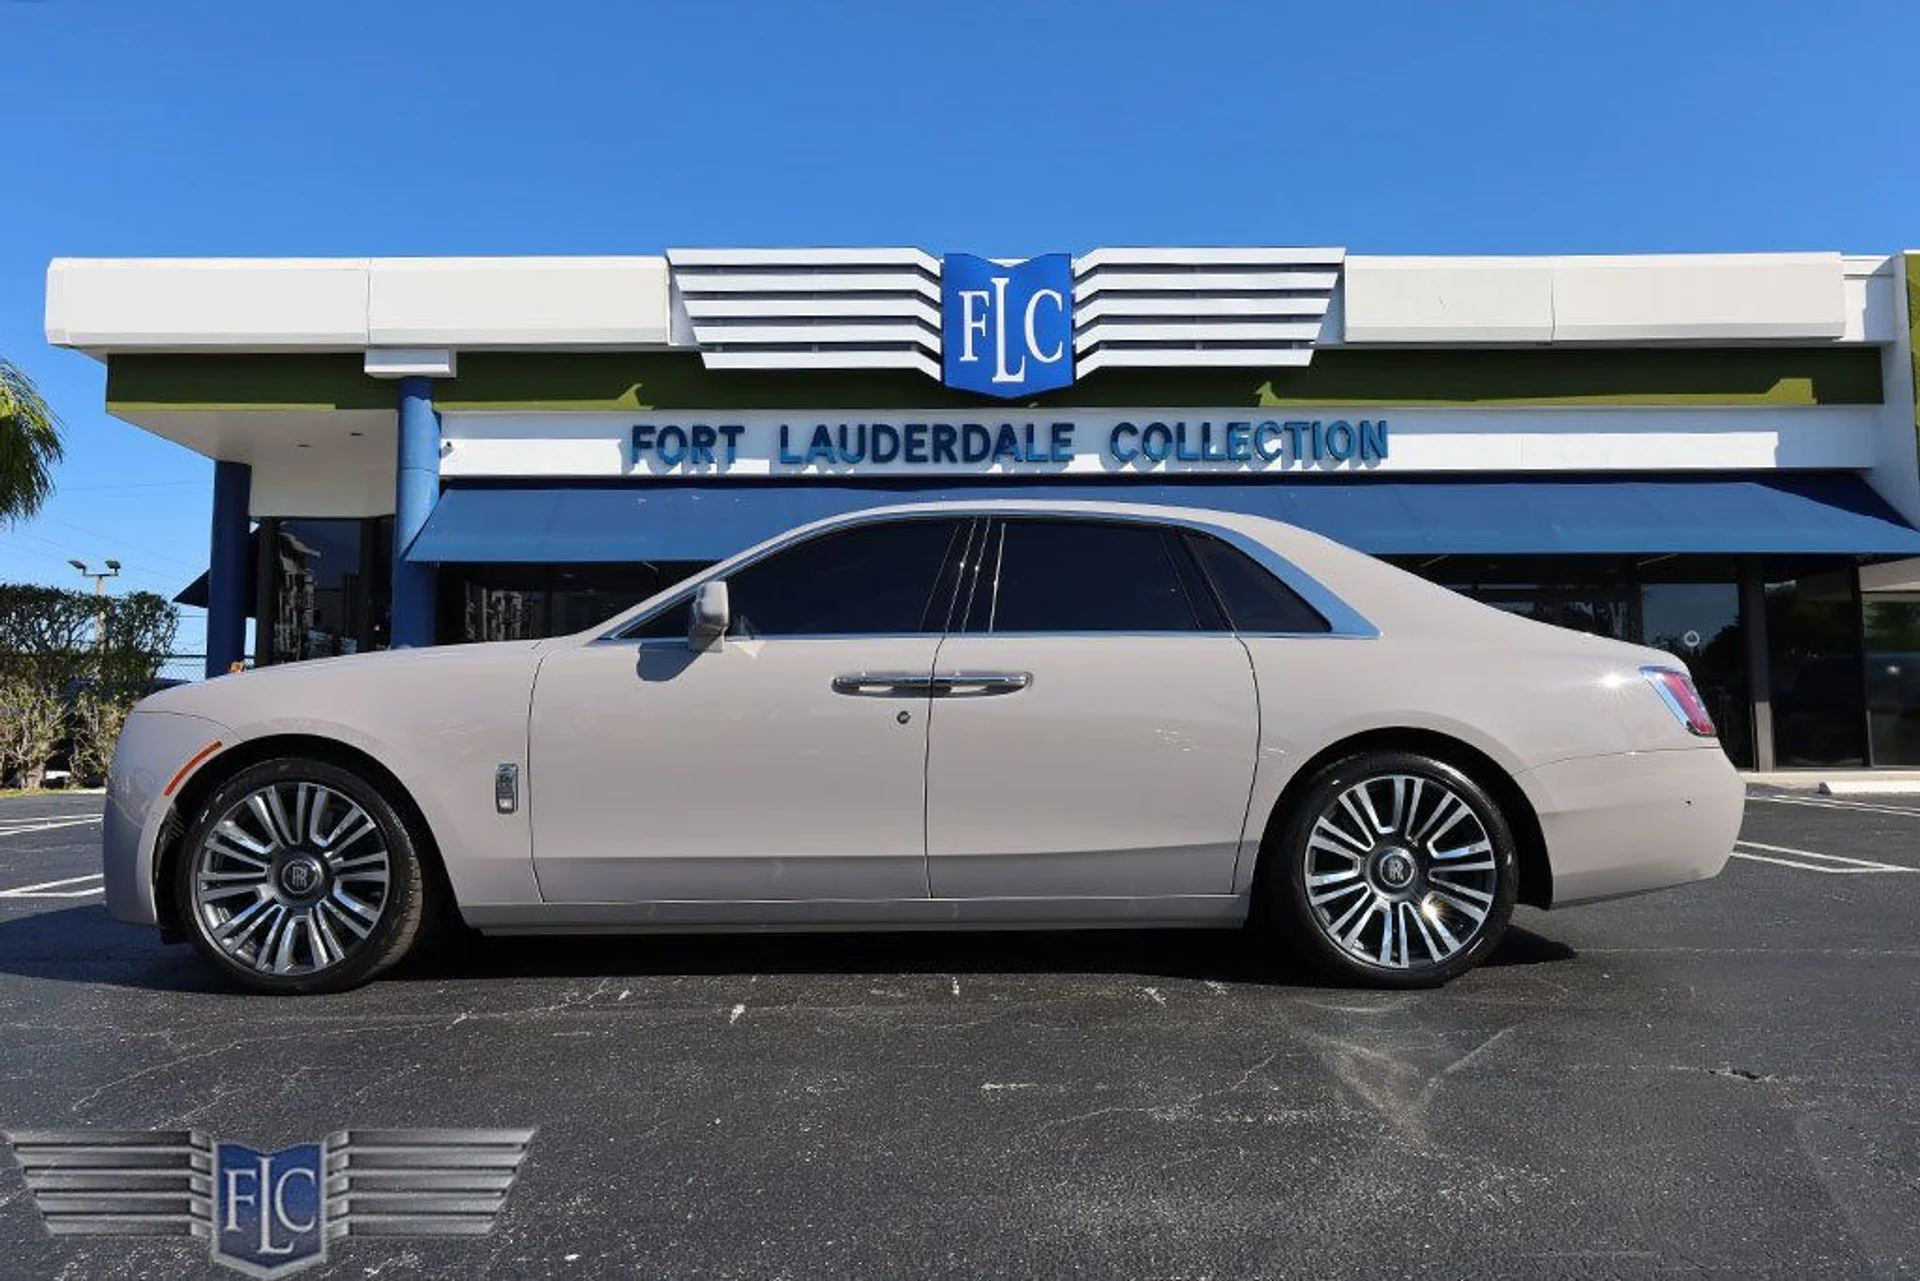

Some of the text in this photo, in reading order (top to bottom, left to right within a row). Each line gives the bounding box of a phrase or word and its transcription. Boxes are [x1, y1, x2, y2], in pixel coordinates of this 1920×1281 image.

[959, 277, 1064, 382] FLC
[631, 420, 1388, 464] FORT LAUDERDALE COLLECTION
